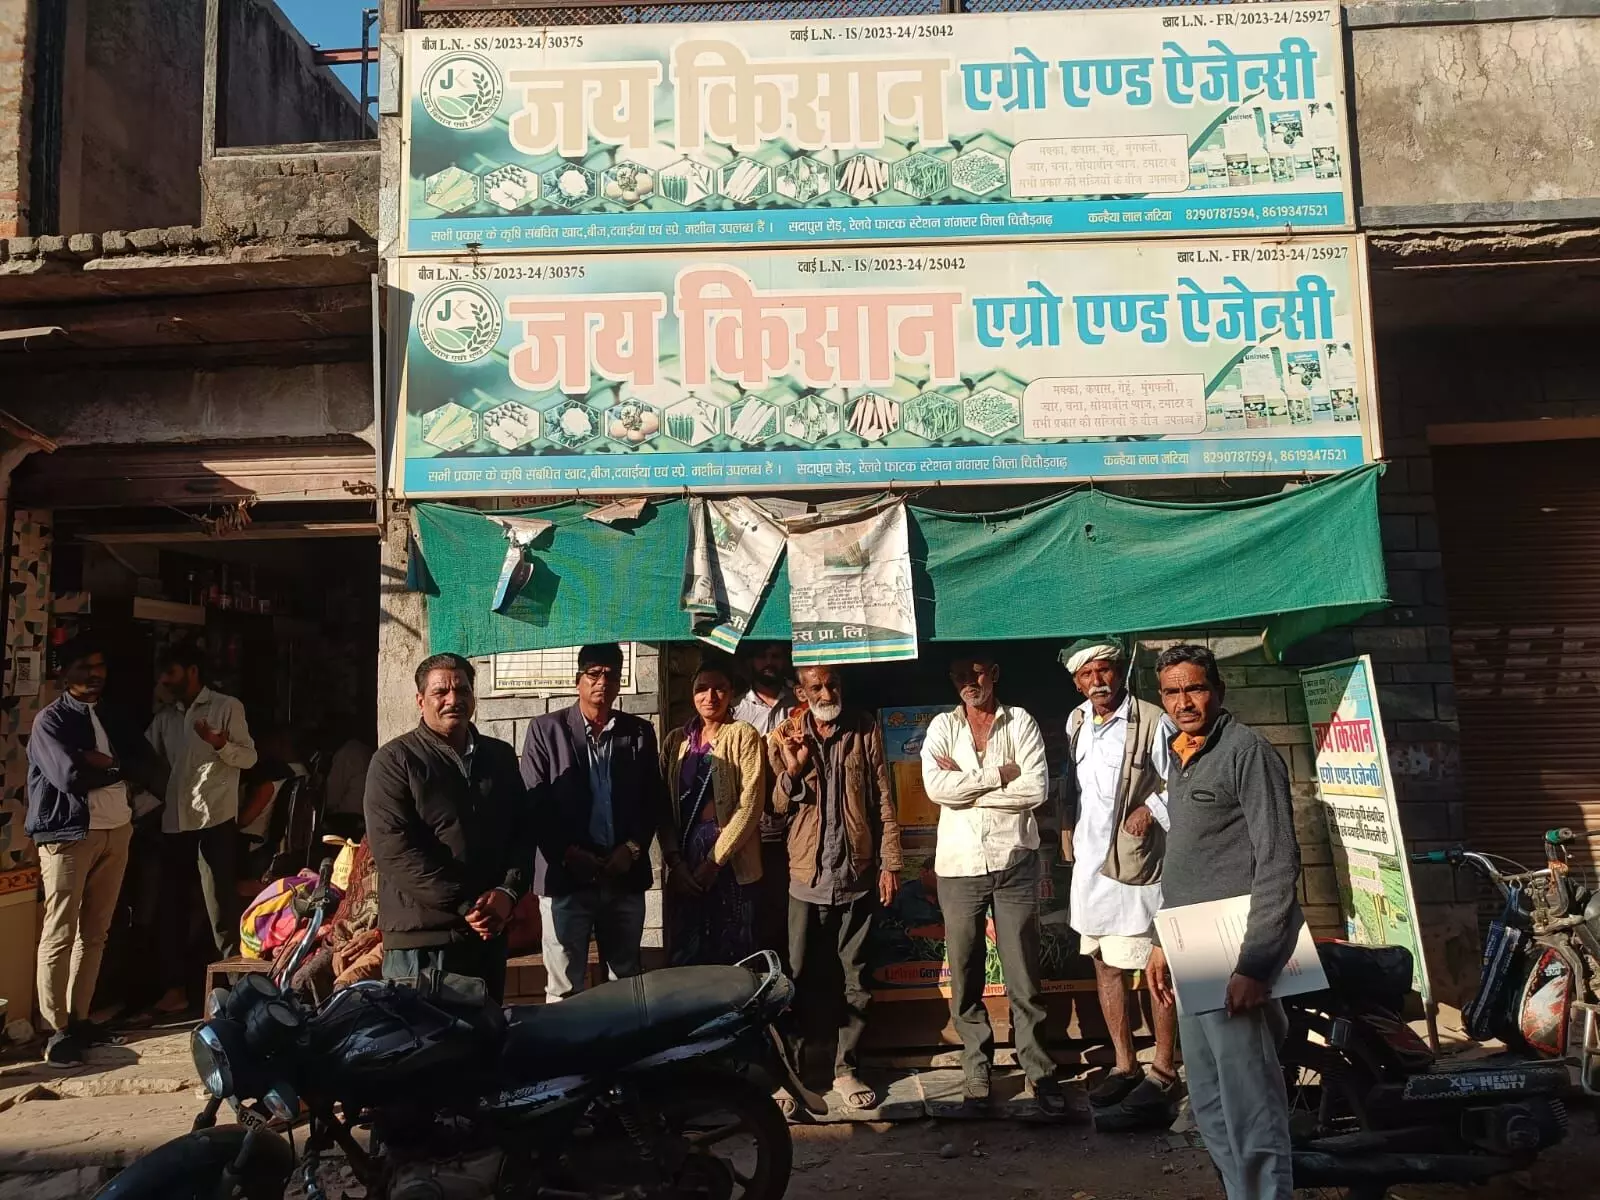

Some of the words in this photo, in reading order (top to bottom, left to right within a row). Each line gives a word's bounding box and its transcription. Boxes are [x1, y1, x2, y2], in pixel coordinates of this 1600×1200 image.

[1162, 15, 1179, 28] खाद
[1182, 14, 1207, 27] L.N.
[1216, 10, 1331, 26] FR/2023-24/25927
[790, 27, 809, 41] दवाई
[811, 28, 836, 41] L.N.
[845, 24, 954, 39] IS/2023-24/25042
[422, 39, 437, 51] बीज
[440, 39, 464, 51] L.N.
[474, 36, 584, 49] SS/2023-24/30375
[508, 61, 662, 157] जय
[669, 39, 952, 150] किसान
[960, 46, 1050, 113] एग्रो
[1057, 57, 1155, 108] एण्ड
[1161, 36, 1319, 106] ऐजेन्सी
[1088, 208, 1121, 223] कन्हैया
[1122, 210, 1142, 223] लाल
[1144, 207, 1173, 221] जटिया
[1185, 206, 1259, 221] 8290787594,
[1262, 204, 1329, 218] 8619347521
[431, 227, 453, 241] सभी
[456, 230, 483, 242] प्रकार
[486, 226, 497, 240] के
[500, 225, 521, 243] कृषि
[685, 220, 716, 235] मशीन
[719, 223, 753, 234] उपलब्ध
[788, 221, 823, 236] सदापुरा
[849, 216, 872, 231] रेलवे
[875, 219, 906, 231] फाटक
[909, 214, 941, 230] स्टेशन
[980, 213, 1005, 228] जिला
[1177, 250, 1195, 264] खाद
[1197, 249, 1223, 263] L.N.
[1232, 246, 1349, 262] FR/2023-24/25927
[418, 266, 434, 281] बीज
[437, 268, 462, 281] L.N.
[472, 265, 585, 280] SS/2023-24/30375
[798, 257, 817, 273] दवाई
[819, 259, 845, 272] L.N.
[854, 257, 966, 272] IS/2023-24/25042
[507, 292, 667, 394] जय
[675, 266, 964, 389] किसान
[972, 280, 1063, 349] एग्रो
[1072, 293, 1170, 345] एण्ड
[1176, 273, 1336, 342] ऐजेन्सी
[1138, 454, 1159, 465] लाल
[1203, 450, 1278, 464] 8290787594,
[1280, 448, 1347, 462] 8619347521
[428, 467, 451, 482] सभी
[454, 469, 483, 482] प्रकार
[485, 466, 498, 480] के
[500, 466, 523, 484] कृषि
[691, 461, 723, 477] मशीन
[726, 463, 762, 477] उपलब्ध
[796, 462, 833, 477] सदापुरा
[858, 456, 882, 473] रेलवे
[884, 460, 917, 473] फाटक
[920, 456, 952, 472] स्टेशन
[993, 454, 1018, 469] जिला
[818, 628, 838, 640] प्रा.
[842, 625, 867, 639] लि.
[1332, 710, 1375, 754] किसान
[1320, 765, 1335, 786] एग्रो
[1335, 767, 1352, 786] एण्ड
[1451, 1077, 1473, 1088] XL
